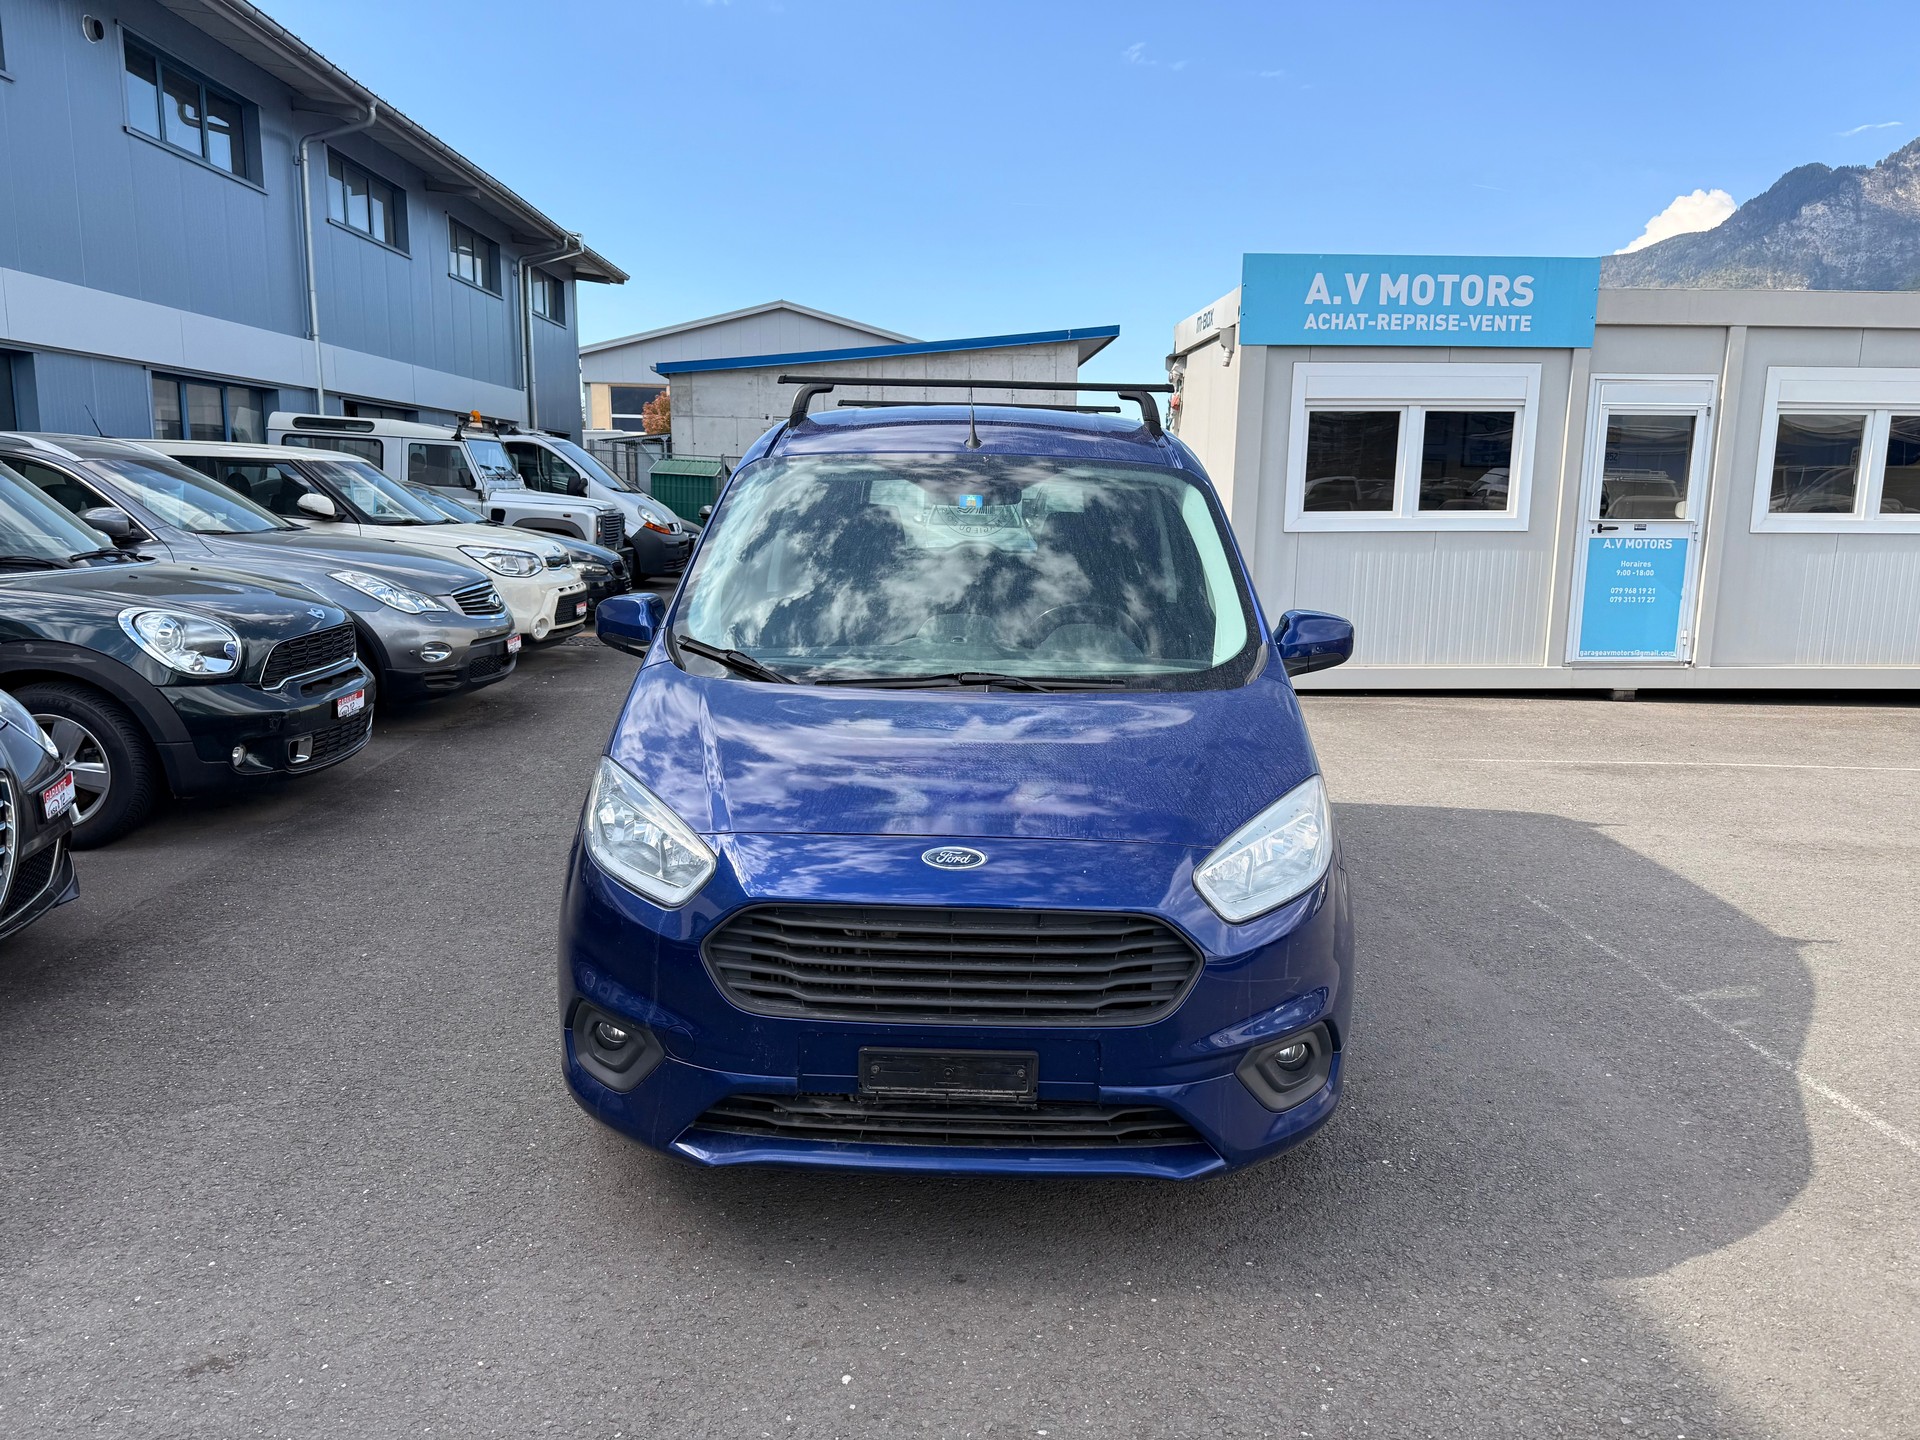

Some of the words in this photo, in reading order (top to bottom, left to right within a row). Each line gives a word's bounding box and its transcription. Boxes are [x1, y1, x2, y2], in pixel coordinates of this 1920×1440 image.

[1304, 273, 1369, 305] A.V
[1378, 273, 1535, 306] MOTORS
[1303, 312, 1532, 332] ACHAT-REPRISE-VENTE
[1603, 538, 1623, 549] A.V
[1625, 538, 1673, 549] MOTORS
[1579, 649, 1676, 658] garageavmotors@gmail.com
[936, 850, 971, 864] Ford
